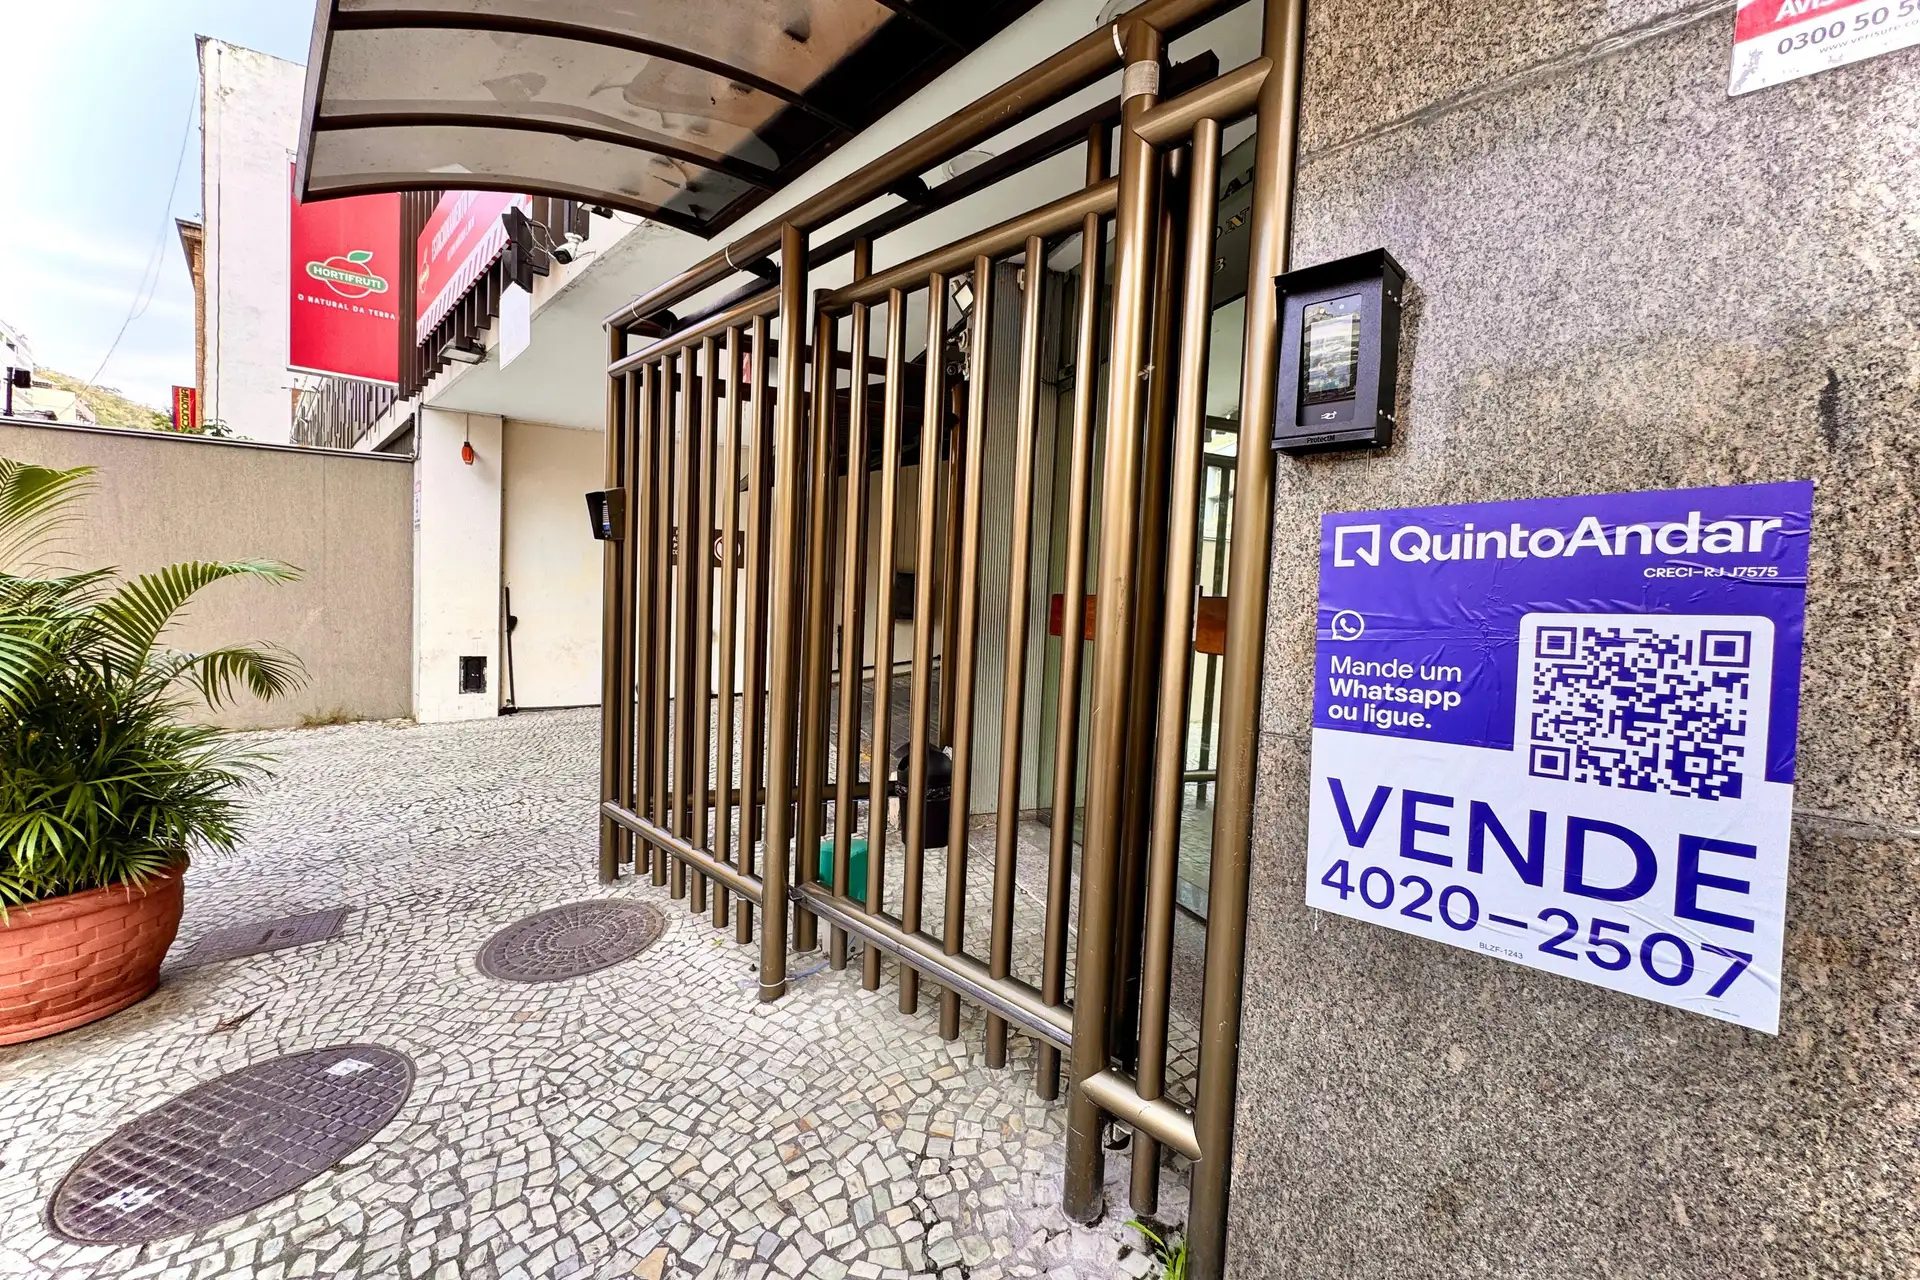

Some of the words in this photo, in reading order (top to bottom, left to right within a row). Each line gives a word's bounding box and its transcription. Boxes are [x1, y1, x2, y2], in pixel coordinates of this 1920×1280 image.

[1777, 21, 1845, 55] 0300
[1853, 7, 1889, 31] 50
[313, 265, 381, 289] HORTIFRUTI
[297, 293, 304, 301] O
[307, 295, 349, 311] NATURAL
[352, 305, 365, 314] DA
[368, 308, 396, 321] TERRA
[1389, 511, 1782, 563] QuintoAndar
[1643, 567, 1724, 578] CRECI-RJ
[1727, 566, 1779, 578] J7575
[1330, 655, 1414, 679] Mande
[1420, 664, 1462, 682] um
[1328, 677, 1462, 711] Whatsapp
[1328, 703, 1358, 721] ou
[1363, 703, 1432, 729] ligue.
[1327, 776, 1758, 933] VENDE
[1321, 858, 1753, 999] 4020-2507
